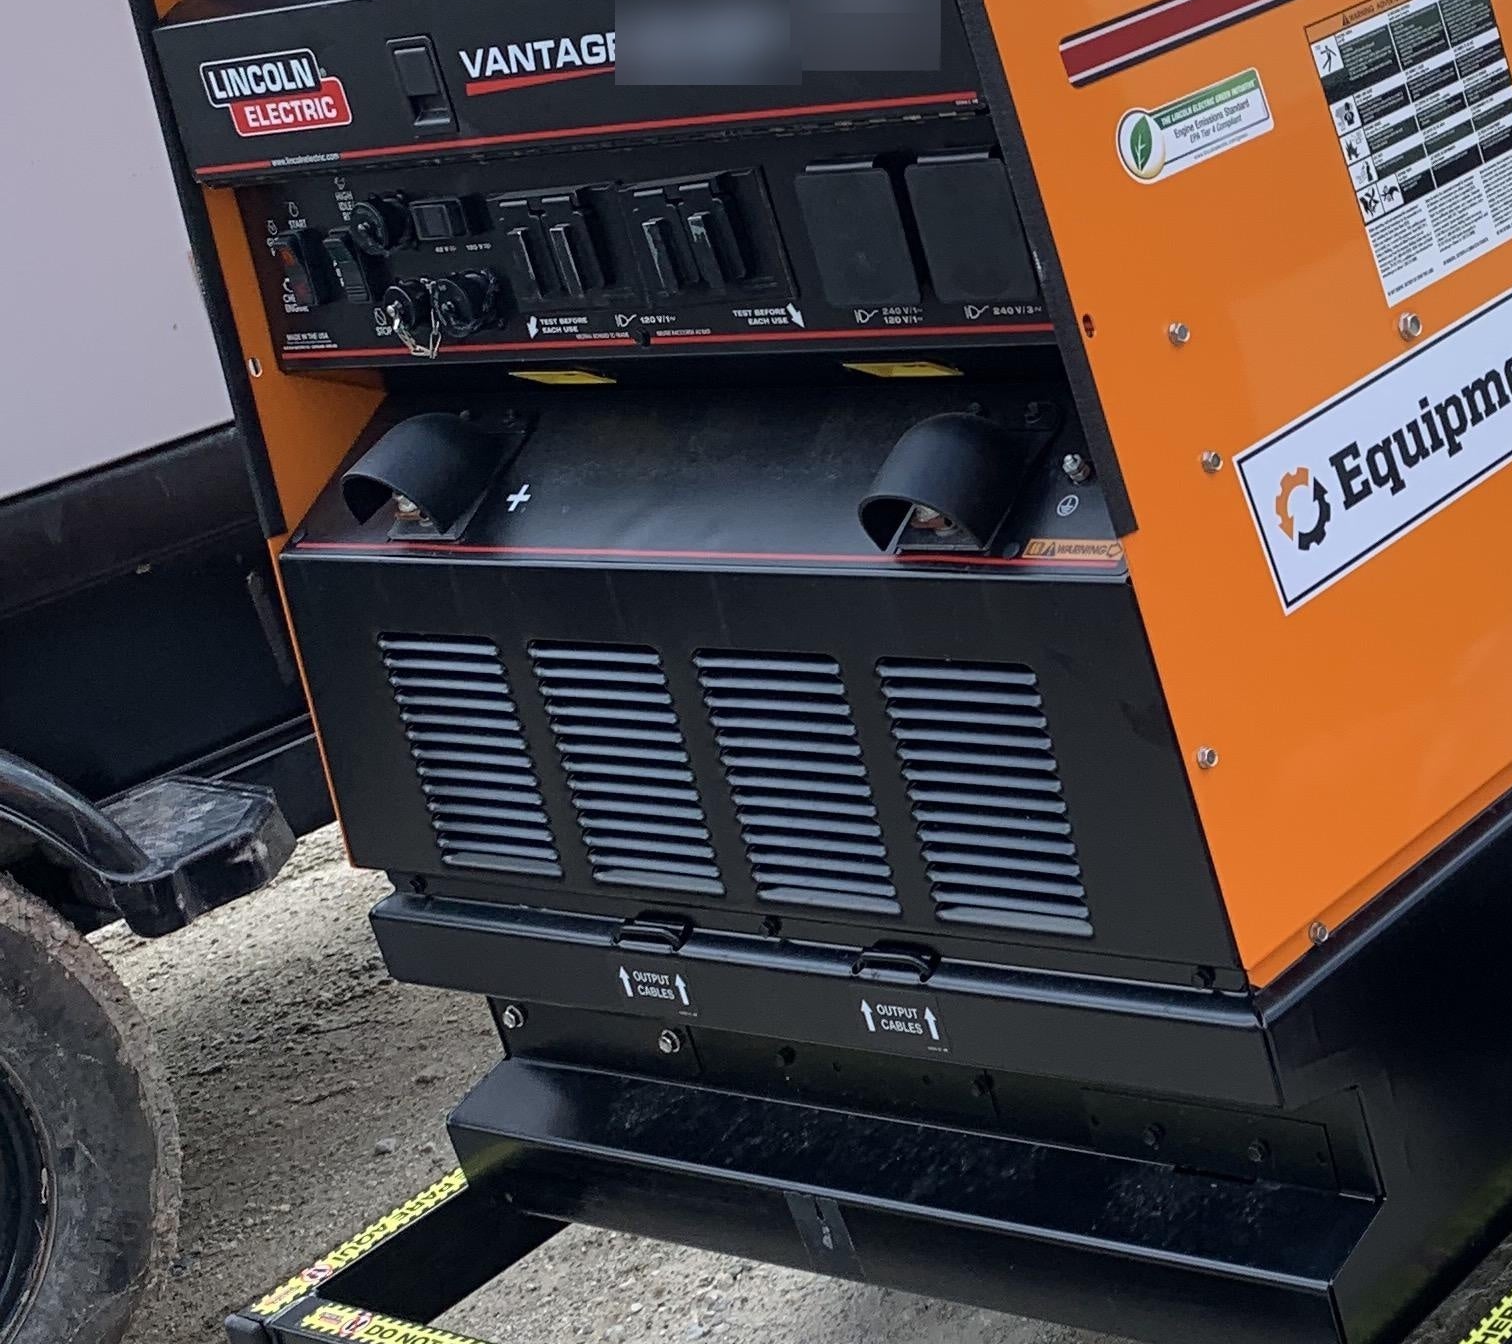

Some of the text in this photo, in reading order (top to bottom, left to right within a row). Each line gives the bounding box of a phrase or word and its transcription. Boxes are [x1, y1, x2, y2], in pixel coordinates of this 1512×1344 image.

[208, 58, 316, 100] LINCOLN
[244, 96, 338, 128] ELECTRIC
[1173, 122, 1195, 139] Engine
[1194, 110, 1224, 129] Emissions
[732, 308, 786, 317] TEST BEFORE
[992, 306, 1014, 315] 240
[539, 316, 588, 326] TEST BEFORE
[748, 316, 789, 325] EACH USE
[375, 325, 393, 336] STOP
[542, 325, 579, 334] EACH USE
[632, 969, 671, 987] OUTPUT
[637, 985, 676, 1001] CABLES
[875, 1003, 919, 1020] OUTPUT
[880, 1018, 923, 1035] CABLES
[364, 1324, 399, 1340] DO
